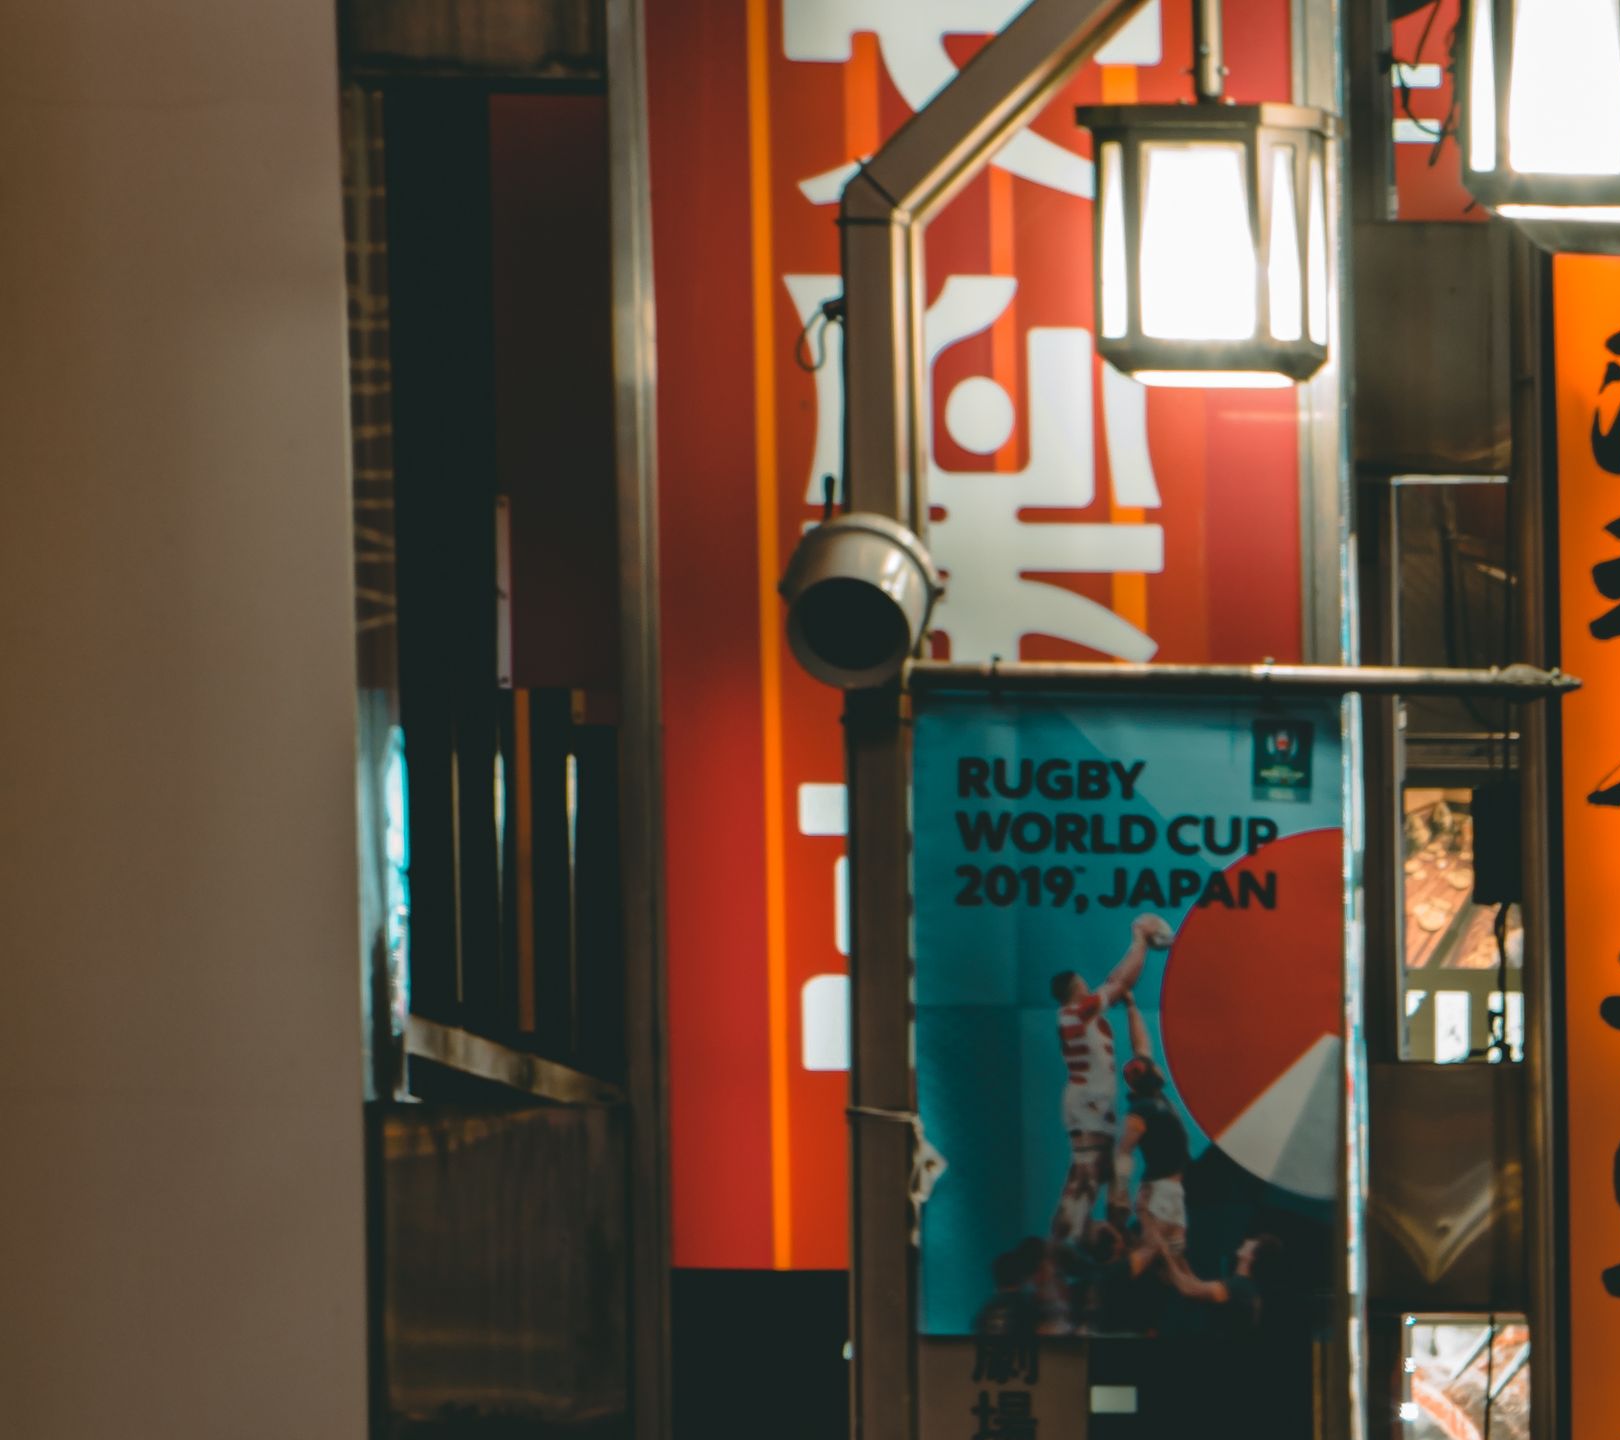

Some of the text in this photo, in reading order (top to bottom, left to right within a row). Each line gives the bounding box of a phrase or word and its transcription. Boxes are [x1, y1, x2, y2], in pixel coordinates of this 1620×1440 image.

[954, 756, 1148, 800] RUGBY
[954, 810, 1281, 857] WORLD CUP
[1096, 866, 1280, 911] JAPAN
